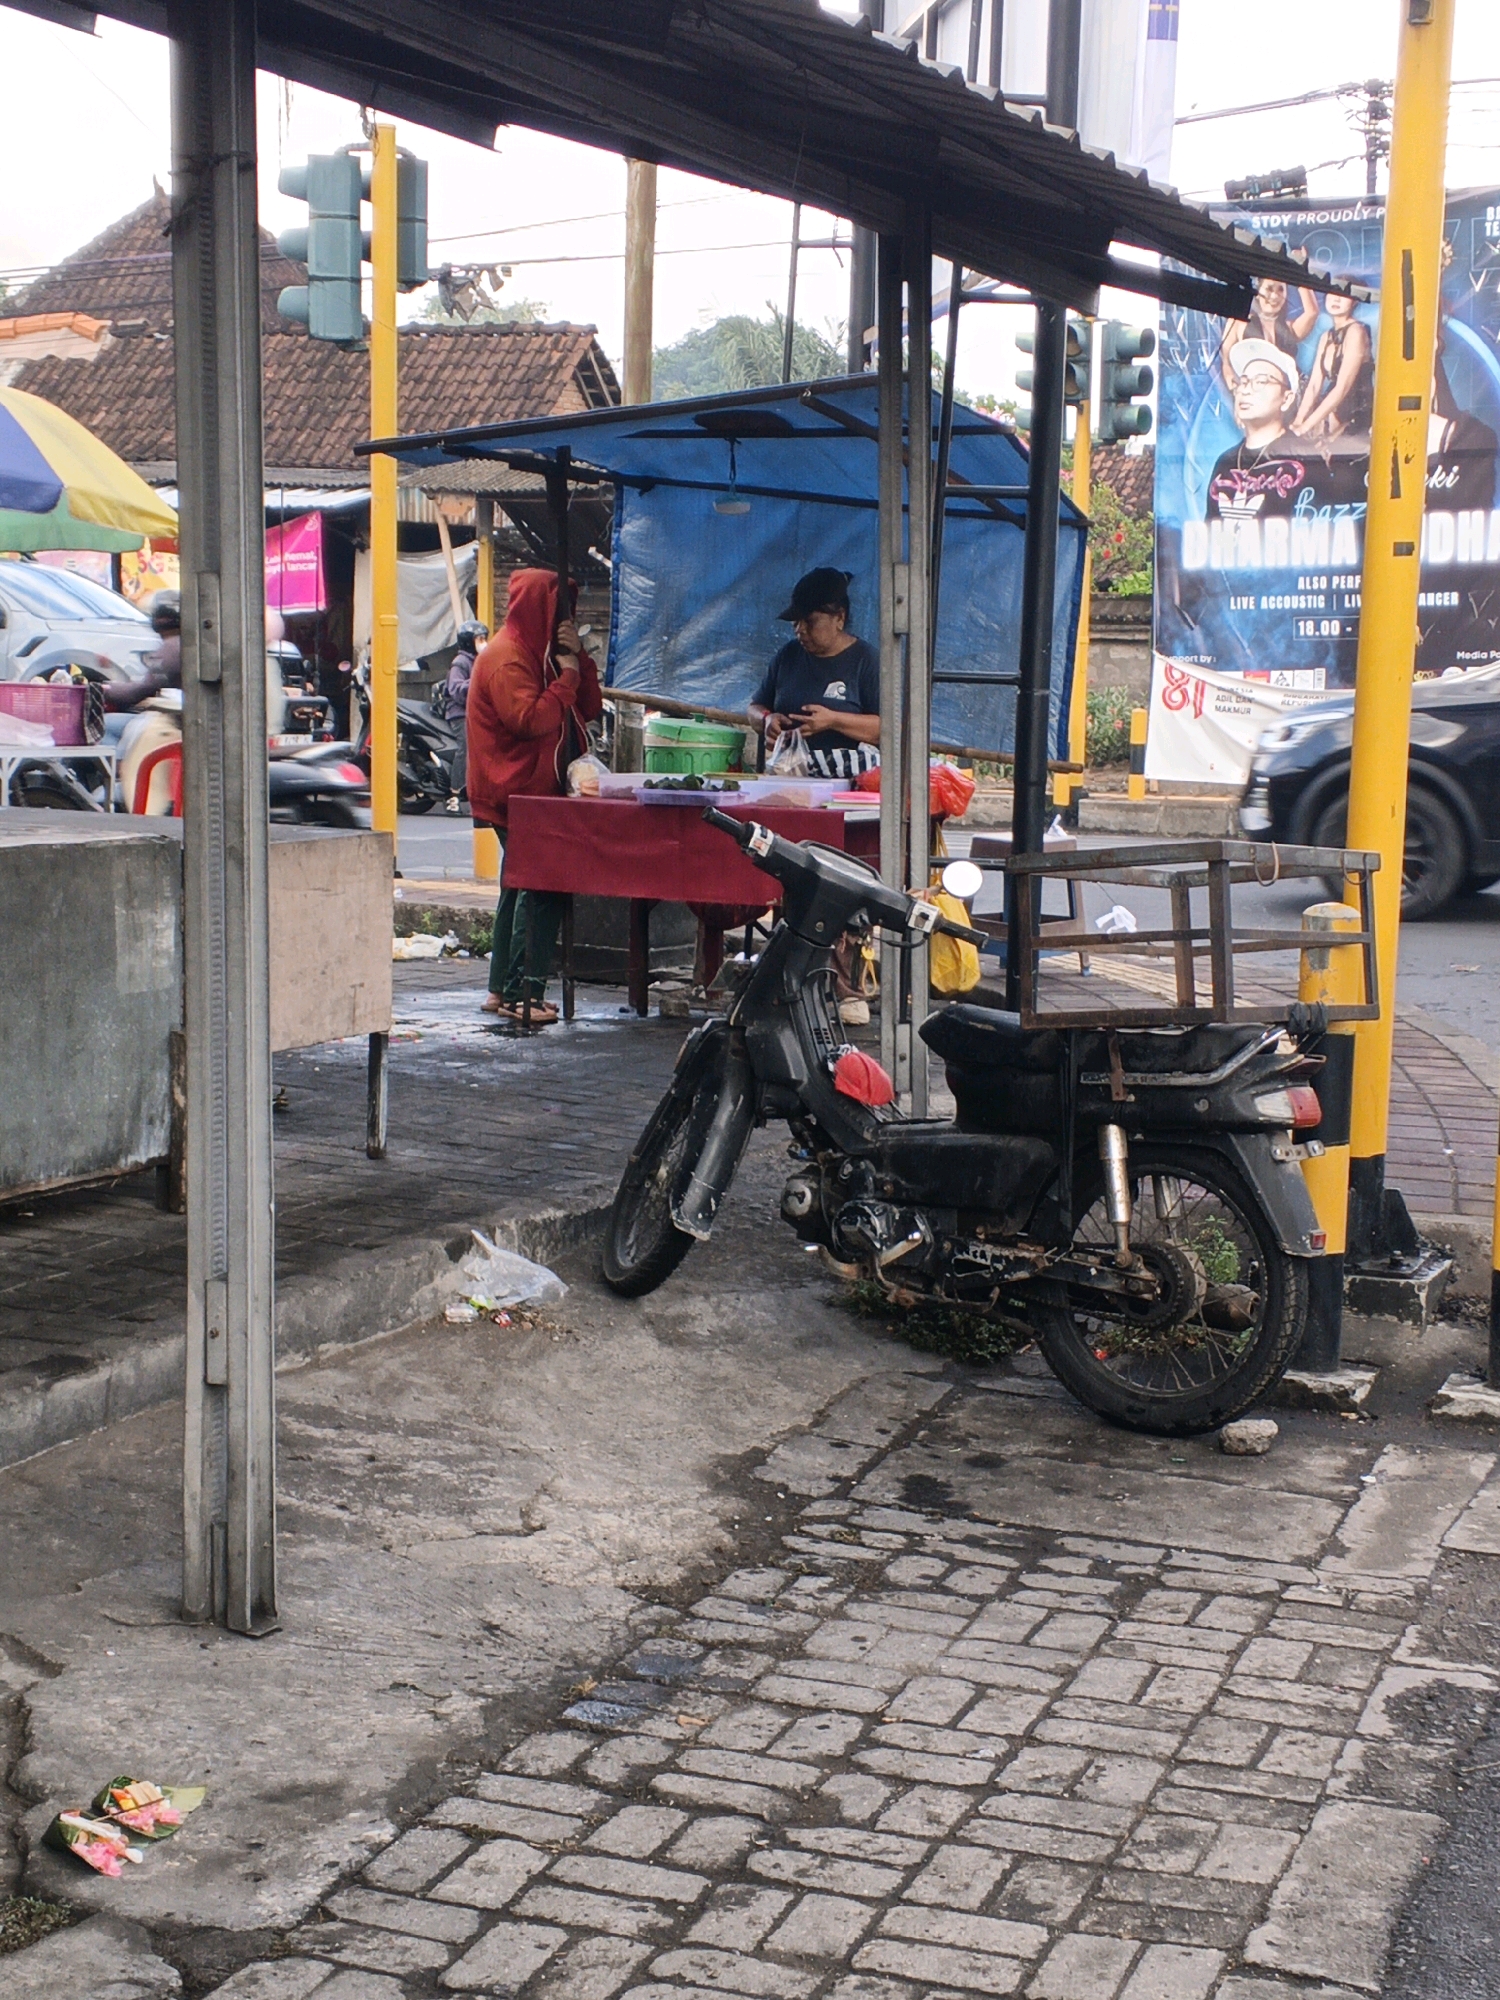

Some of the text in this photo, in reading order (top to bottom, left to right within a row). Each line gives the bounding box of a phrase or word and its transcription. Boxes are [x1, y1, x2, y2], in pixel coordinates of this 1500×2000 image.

[1252, 201, 1386, 229] STDY PROUDLY P
[1485, 221, 1500, 237] TE
[1182, 514, 1358, 569] DHARMA
[1297, 574, 1362, 590] ALSO PERF
[1229, 596, 1256, 610] LIVE
[1260, 594, 1326, 610] ACCOUSTIC
[1417, 591, 1460, 607] ANCER
[1297, 620, 1341, 637] 18.00
[1456, 651, 1488, 660] Media
[1215, 694, 1234, 704] ADIL
[1214, 704, 1252, 715] MAKMUR
